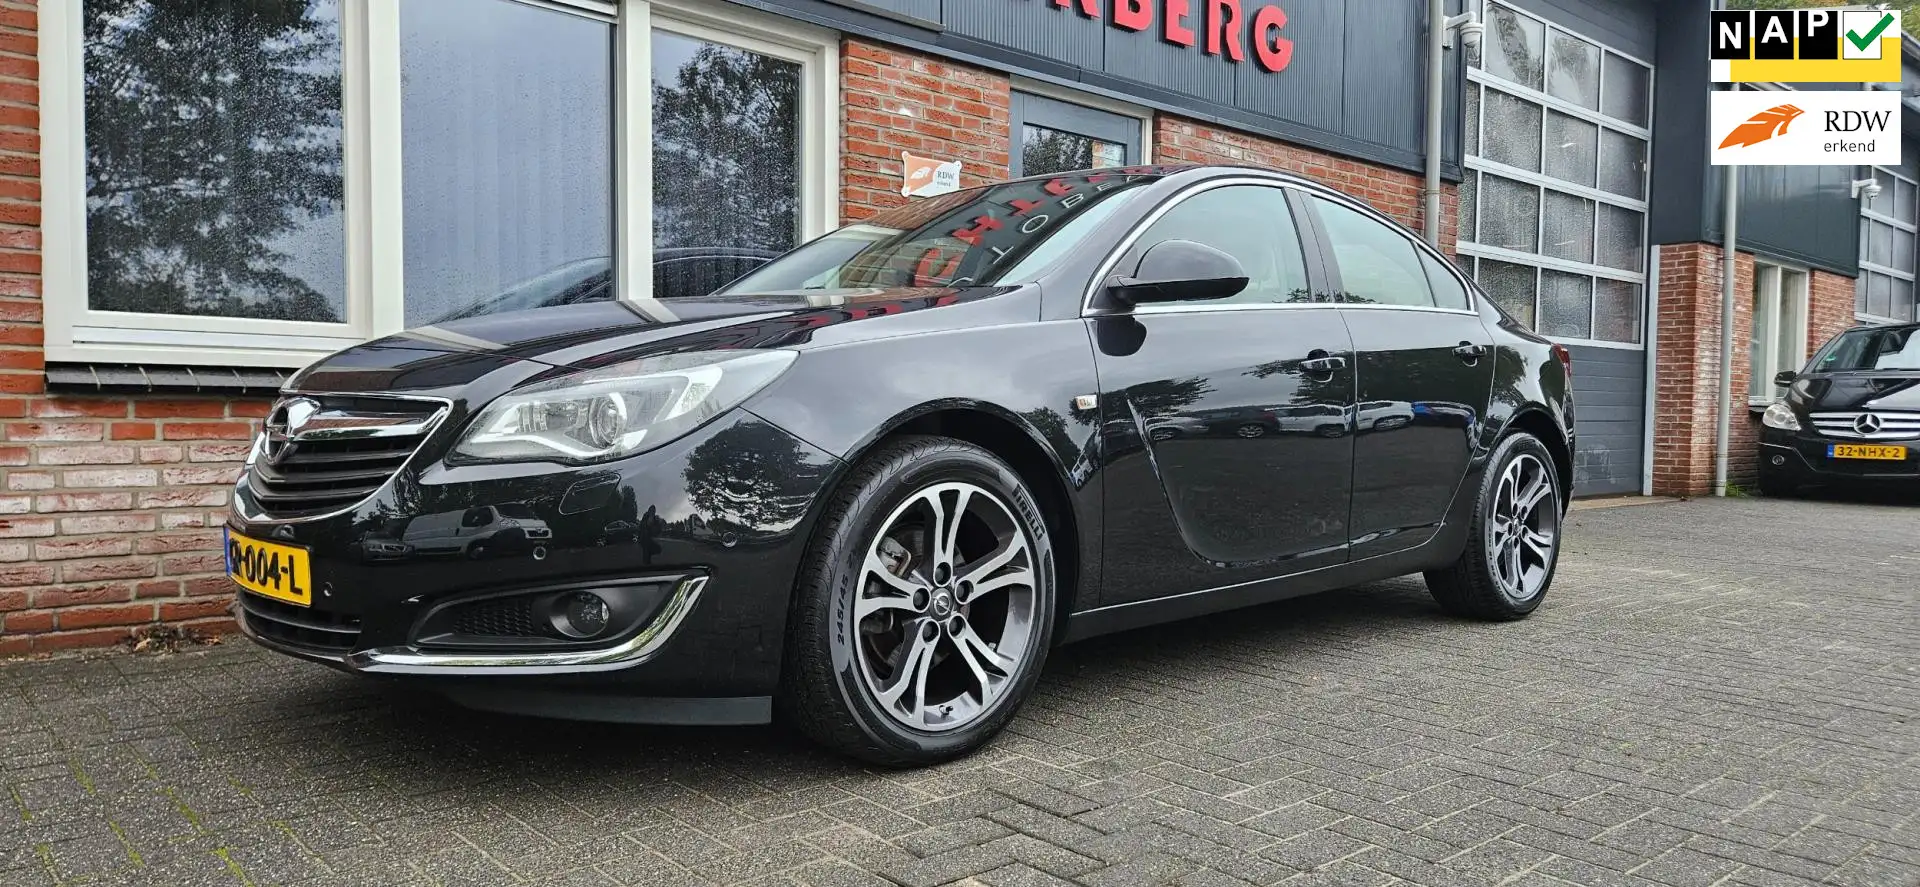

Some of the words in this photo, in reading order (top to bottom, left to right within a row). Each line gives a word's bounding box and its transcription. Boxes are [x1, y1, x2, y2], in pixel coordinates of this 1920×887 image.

[937, 170, 955, 180] RDW
[1838, 446, 1900, 458] 32-NHX-2
[1012, 483, 1045, 541] PIRELLI
